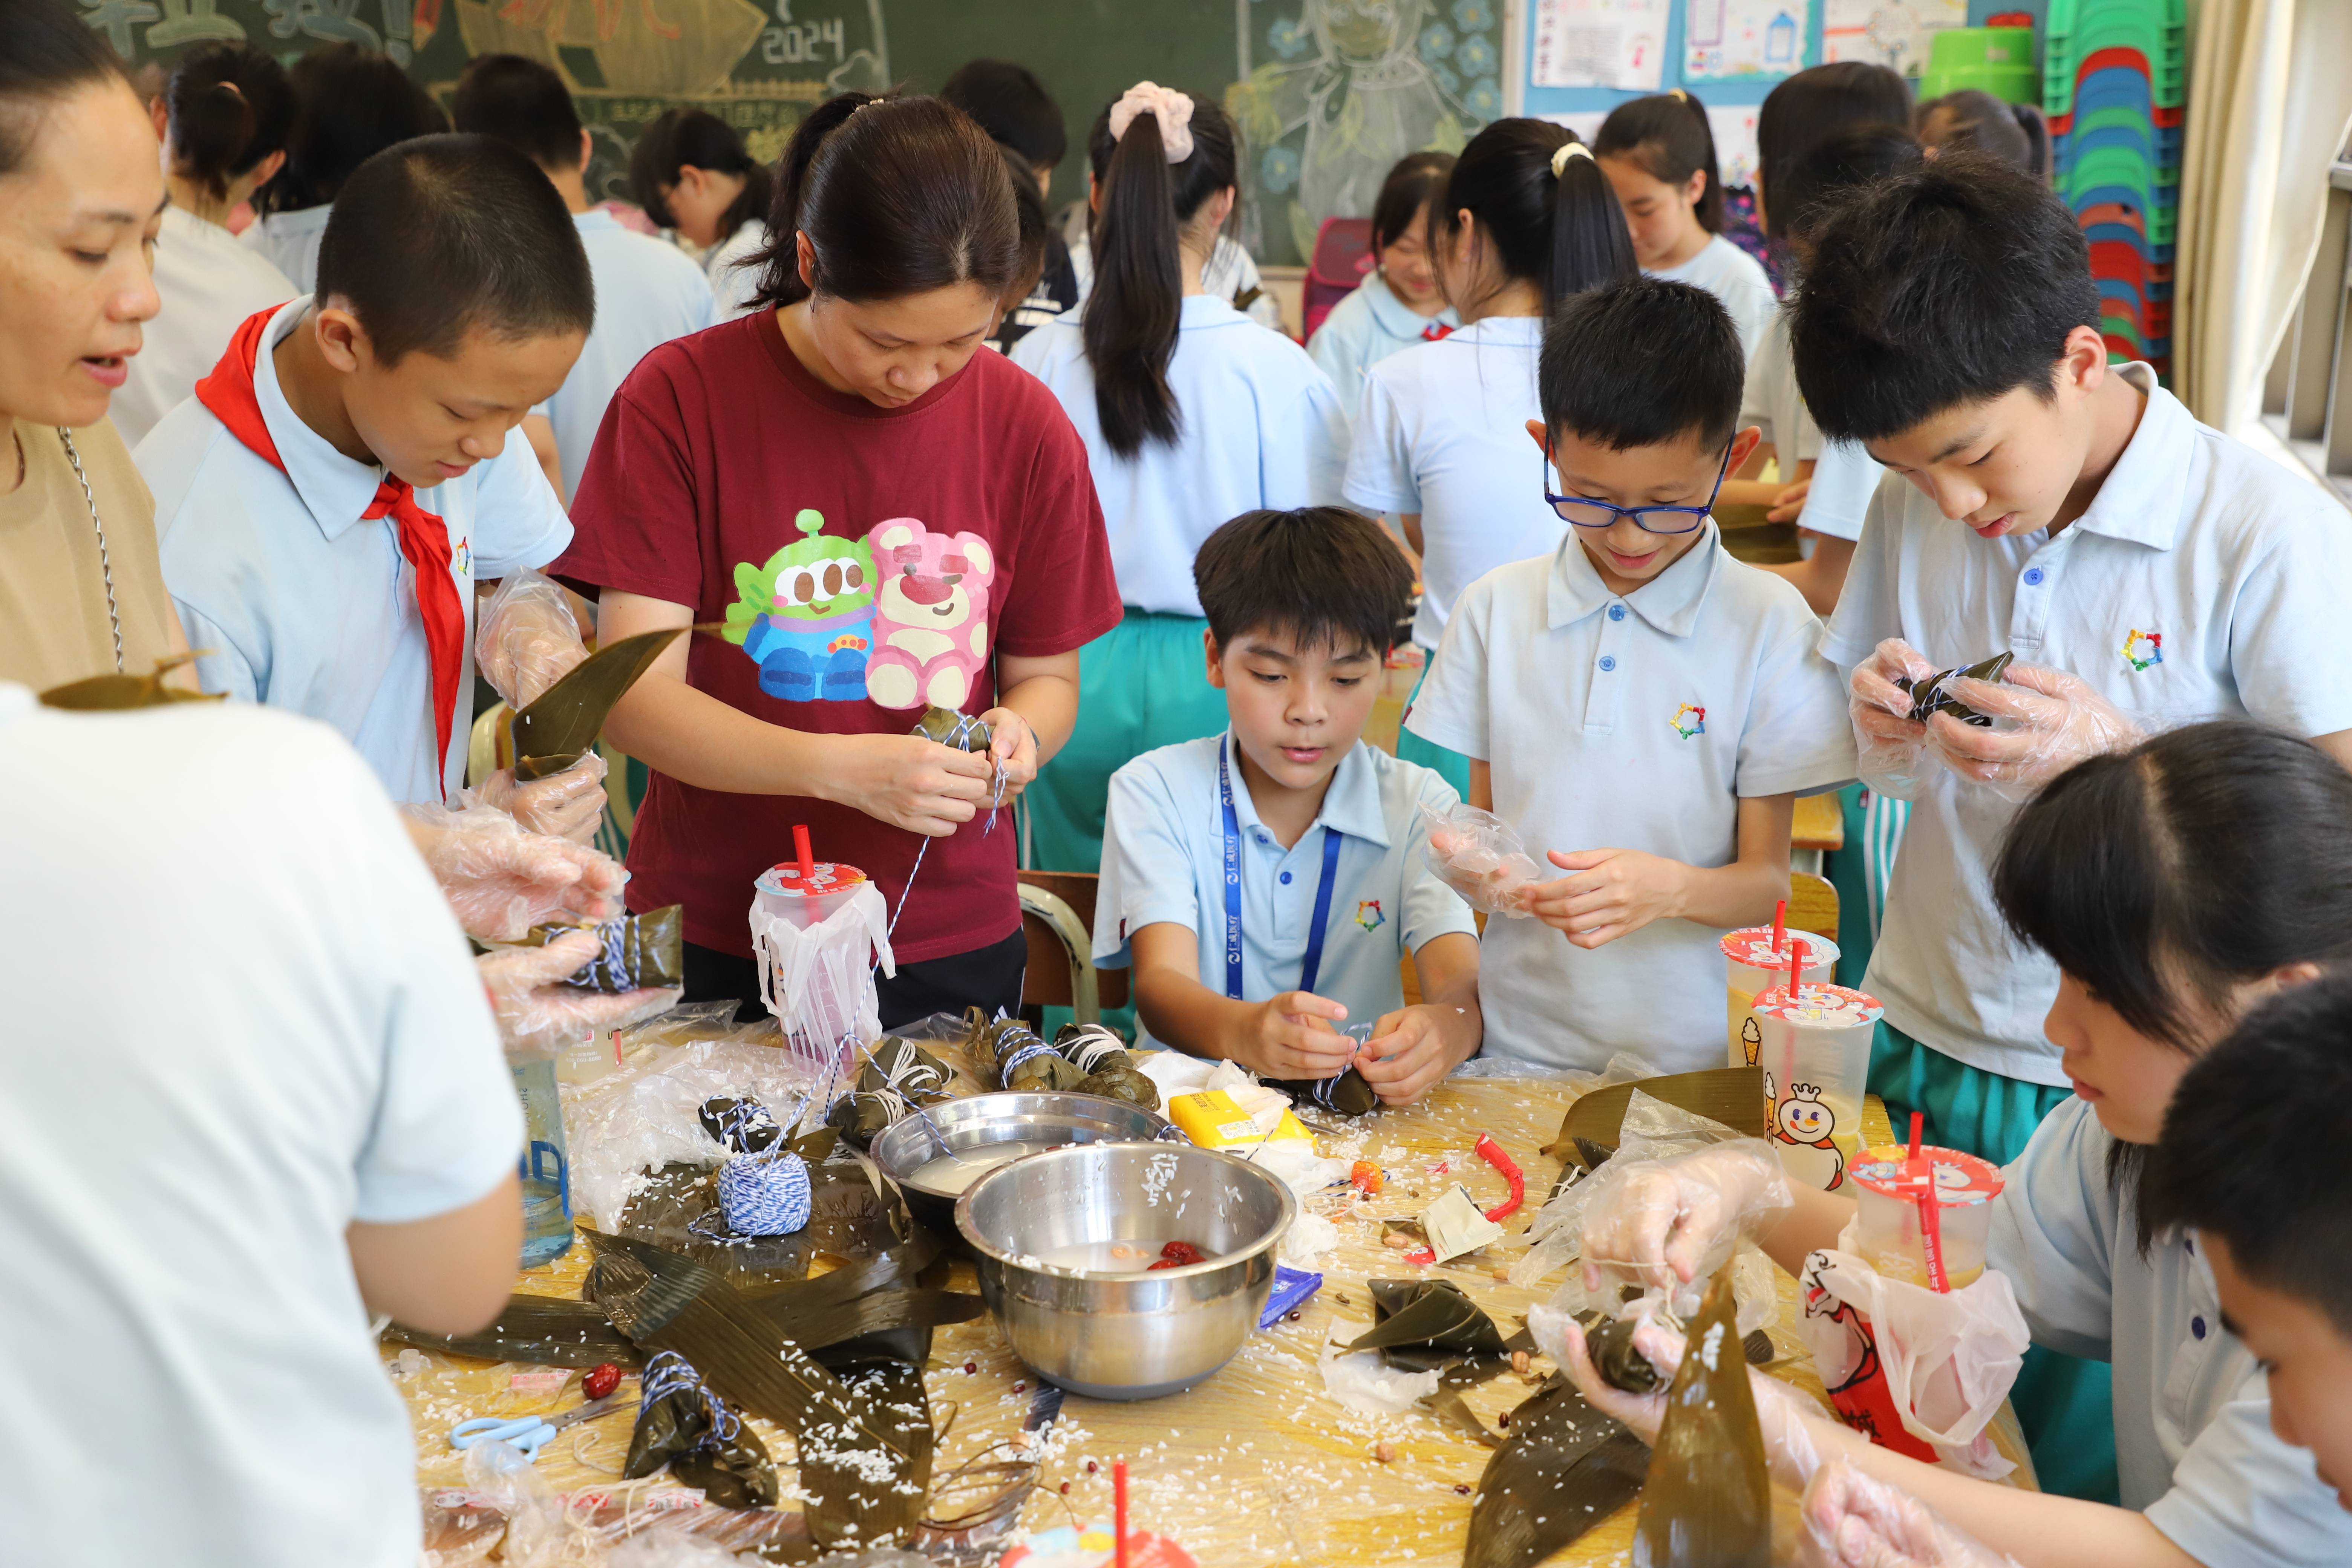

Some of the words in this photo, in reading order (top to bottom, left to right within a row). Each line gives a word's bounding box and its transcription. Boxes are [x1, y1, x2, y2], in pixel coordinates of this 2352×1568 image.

[762, 17, 845, 64] 2024
[1226, 834, 1236, 871] 仁成医疗
[1228, 915, 1238, 952] 仁成医疗
